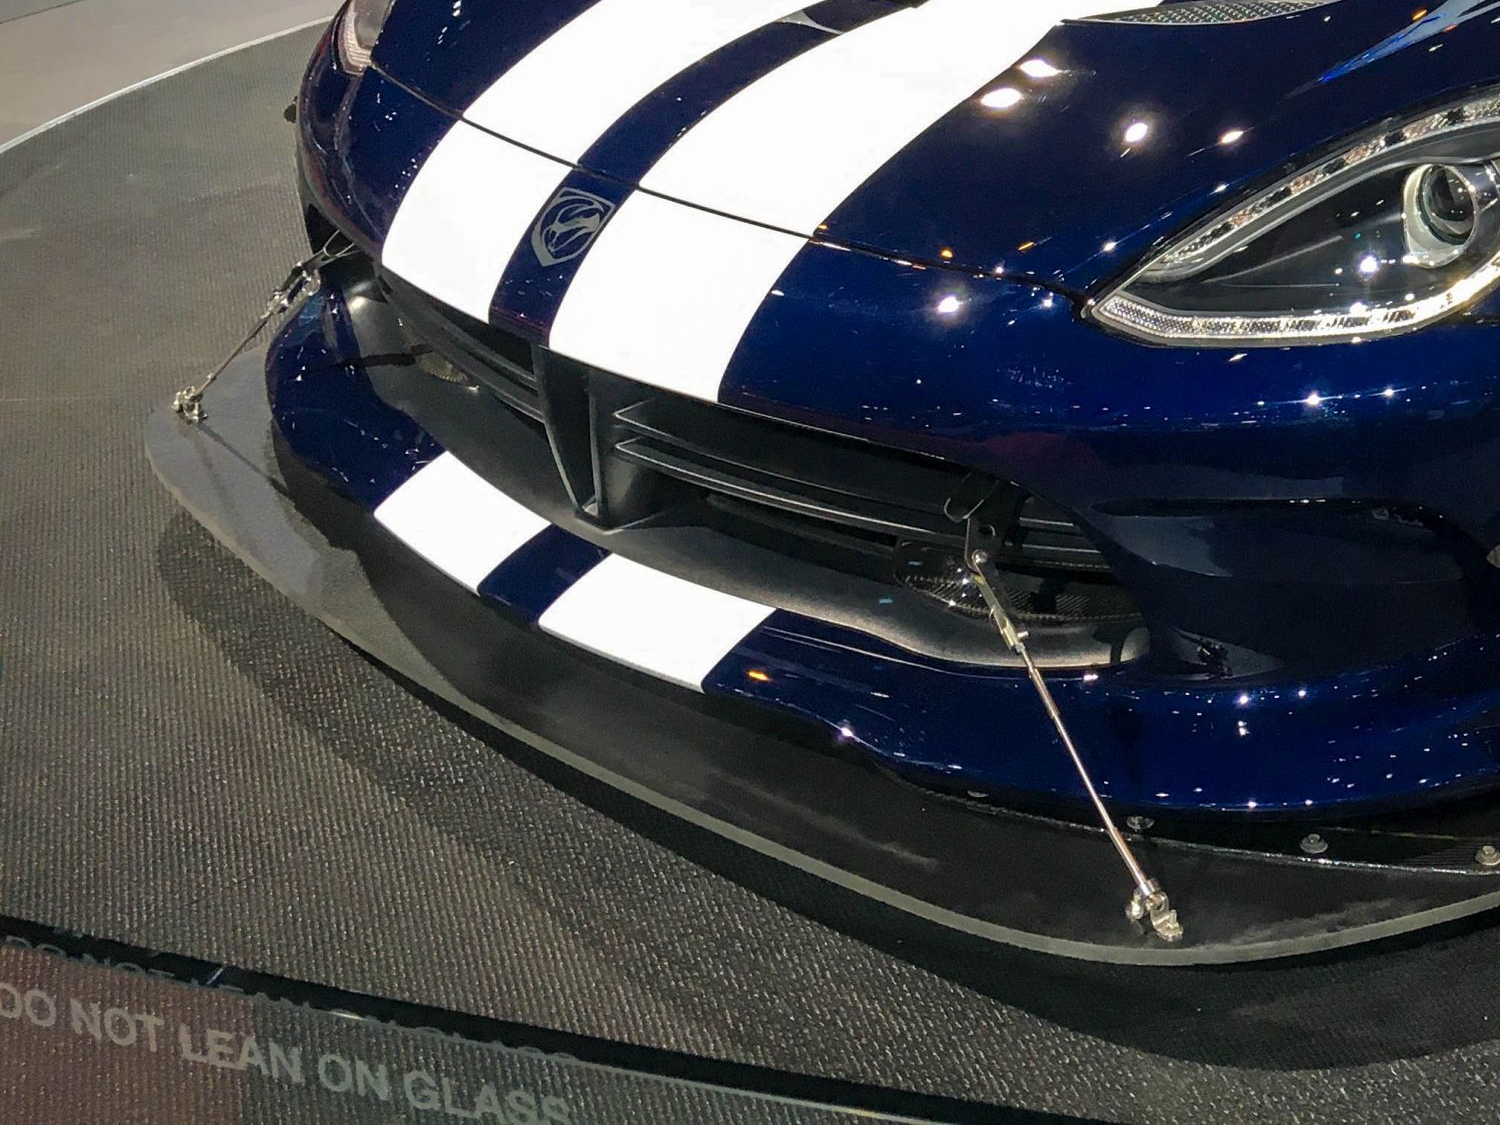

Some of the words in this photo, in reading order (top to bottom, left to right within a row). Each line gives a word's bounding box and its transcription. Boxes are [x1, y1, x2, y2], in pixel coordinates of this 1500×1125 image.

[0, 982, 57, 1026] DO
[70, 998, 165, 1054] NOT
[178, 1024, 305, 1084] LEAN
[318, 1054, 391, 1101] ON
[403, 1070, 571, 1125] GLASS
